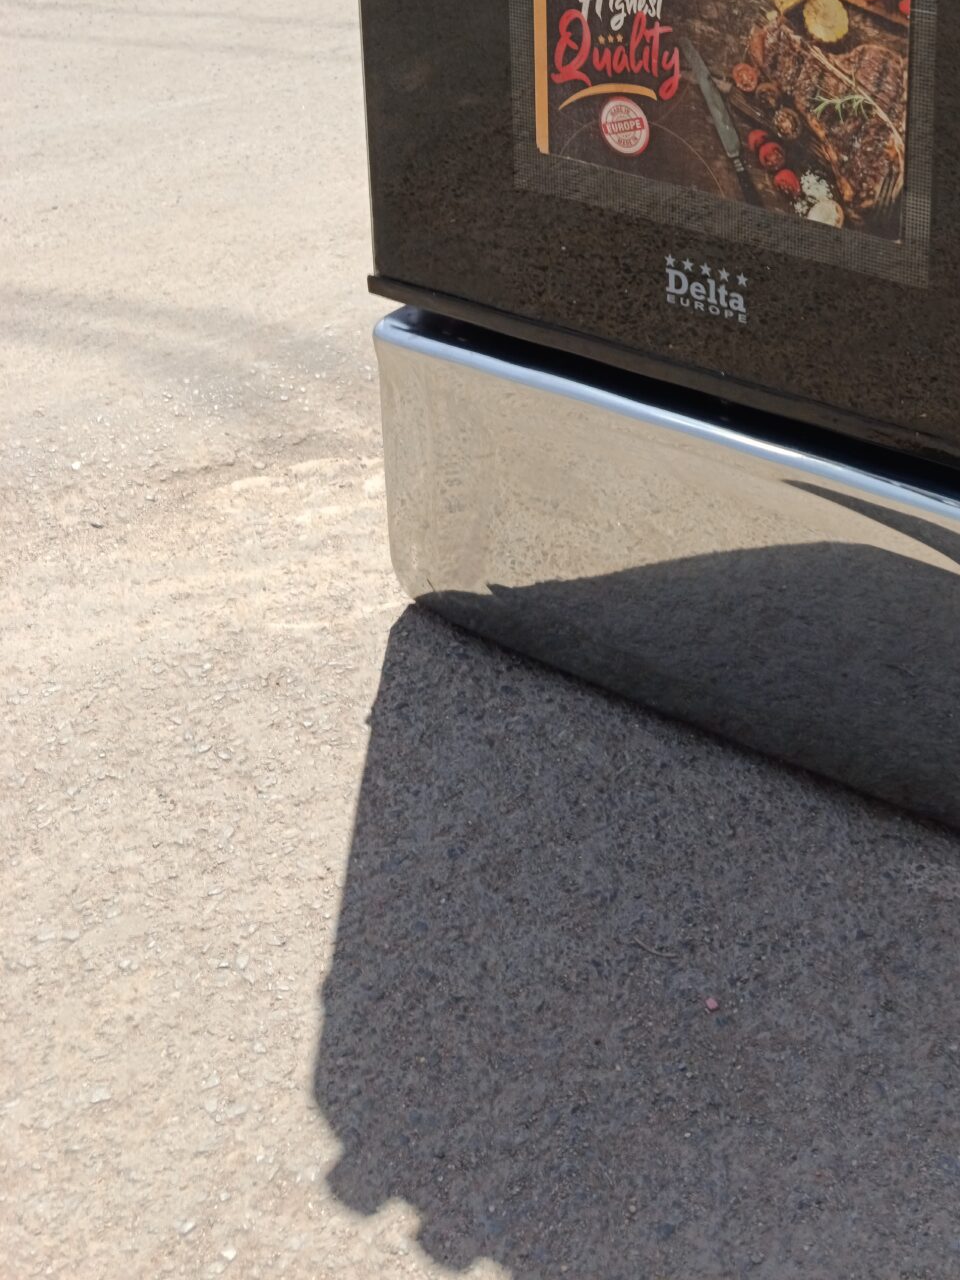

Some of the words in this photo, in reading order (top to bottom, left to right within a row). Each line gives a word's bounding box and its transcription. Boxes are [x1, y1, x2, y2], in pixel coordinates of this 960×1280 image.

[551, 9, 682, 100] Quality
[606, 119, 642, 133] EUROPE
[665, 268, 746, 313] Delta
[666, 293, 747, 324] EUROPE
